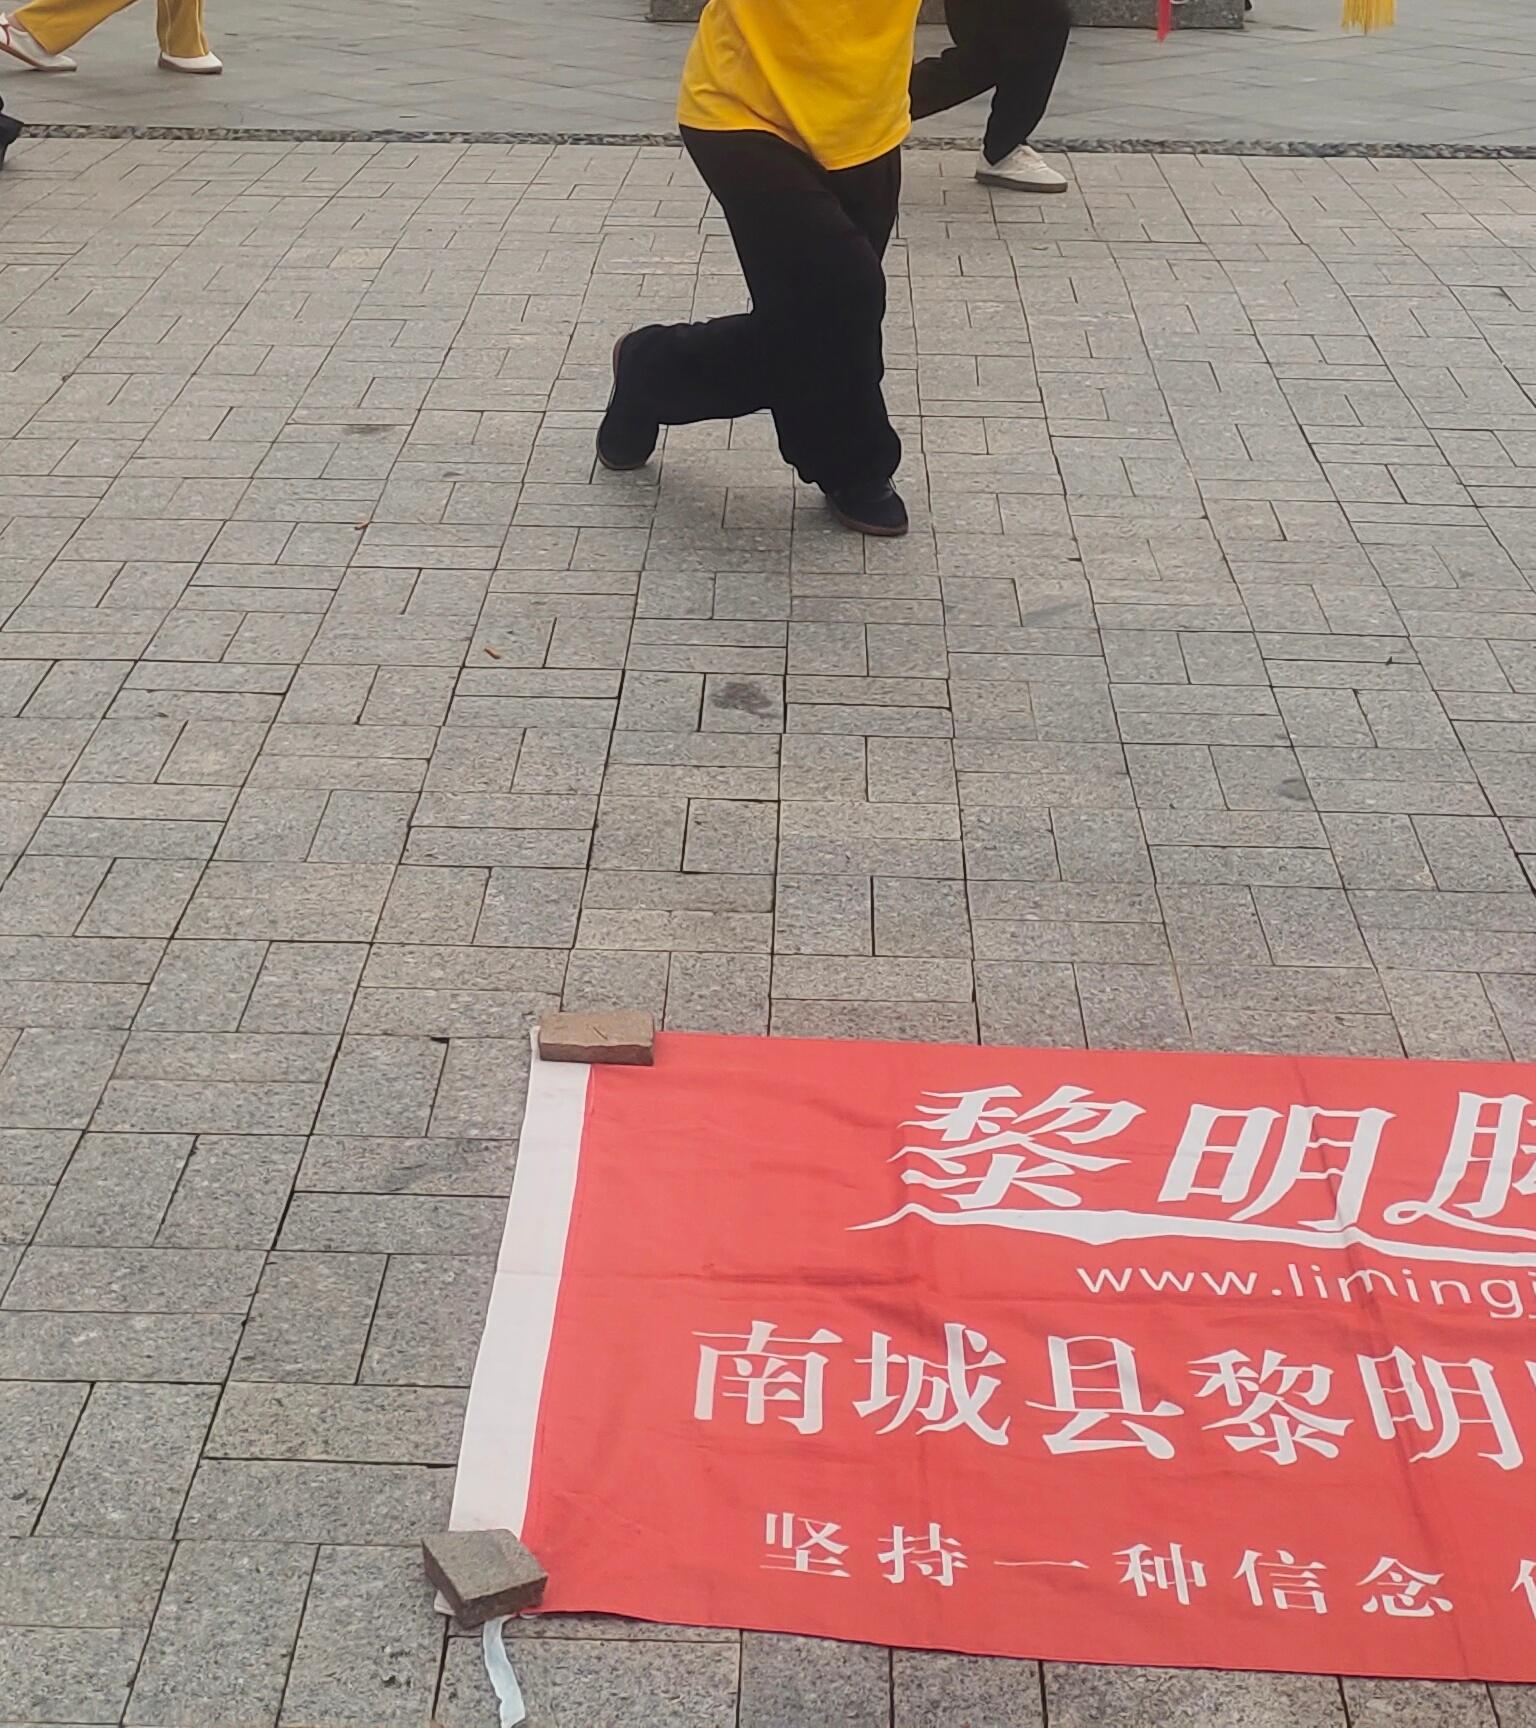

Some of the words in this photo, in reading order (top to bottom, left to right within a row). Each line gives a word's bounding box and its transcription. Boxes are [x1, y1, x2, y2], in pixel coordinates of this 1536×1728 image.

[761, 1511, 1454, 1617] 坚持一种信念
